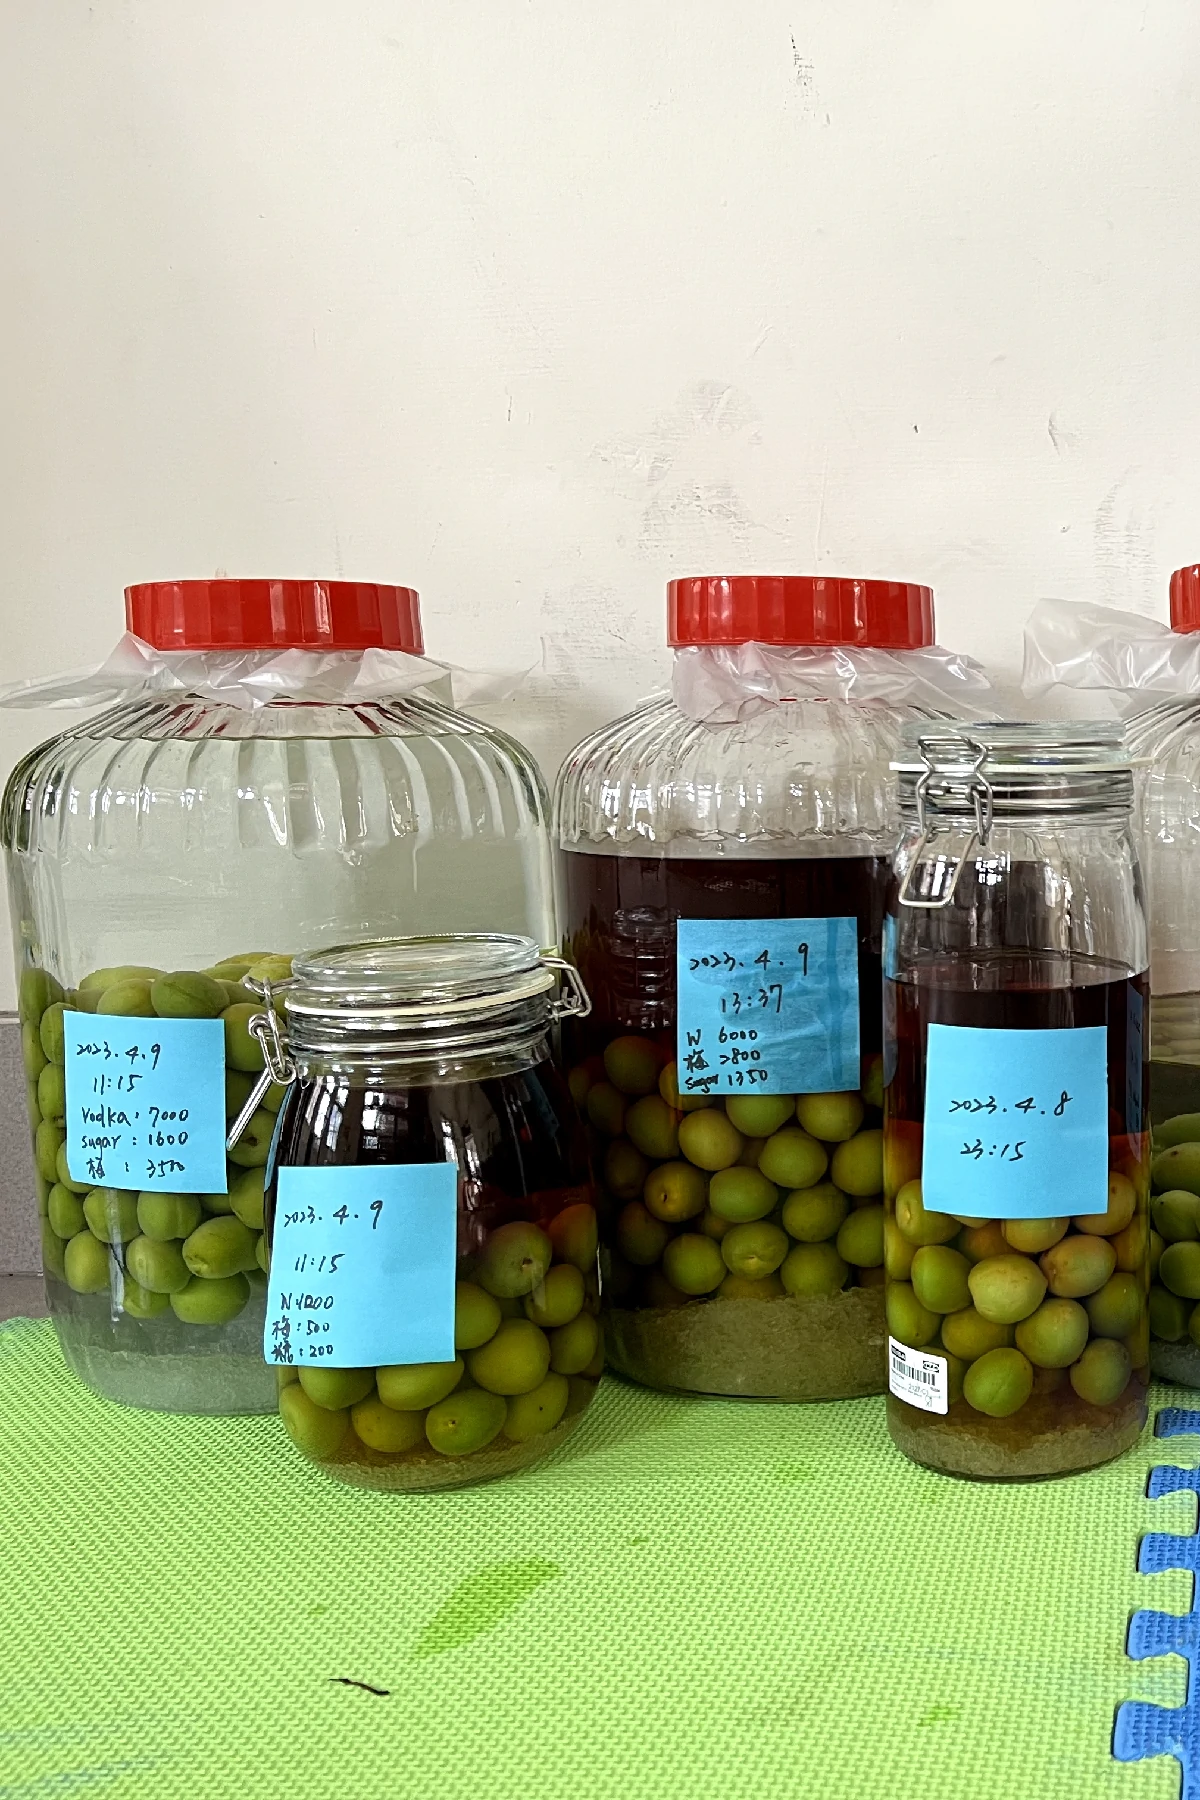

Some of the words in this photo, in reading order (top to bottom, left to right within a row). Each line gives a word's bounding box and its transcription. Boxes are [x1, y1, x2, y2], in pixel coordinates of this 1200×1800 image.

[722, 984, 783, 1015] 13:37
[718, 1026, 758, 1044] 6000
[76, 1040, 161, 1070] 2023.4.9
[93, 1073, 143, 1096] 11:15
[727, 1069, 768, 1087] 1350
[948, 1090, 1074, 1116] 2023.4.8
[149, 1106, 189, 1128] 7000
[148, 1131, 189, 1147] 1600
[958, 1139, 1027, 1162] 23:15
[294, 1253, 346, 1274] 11:15
